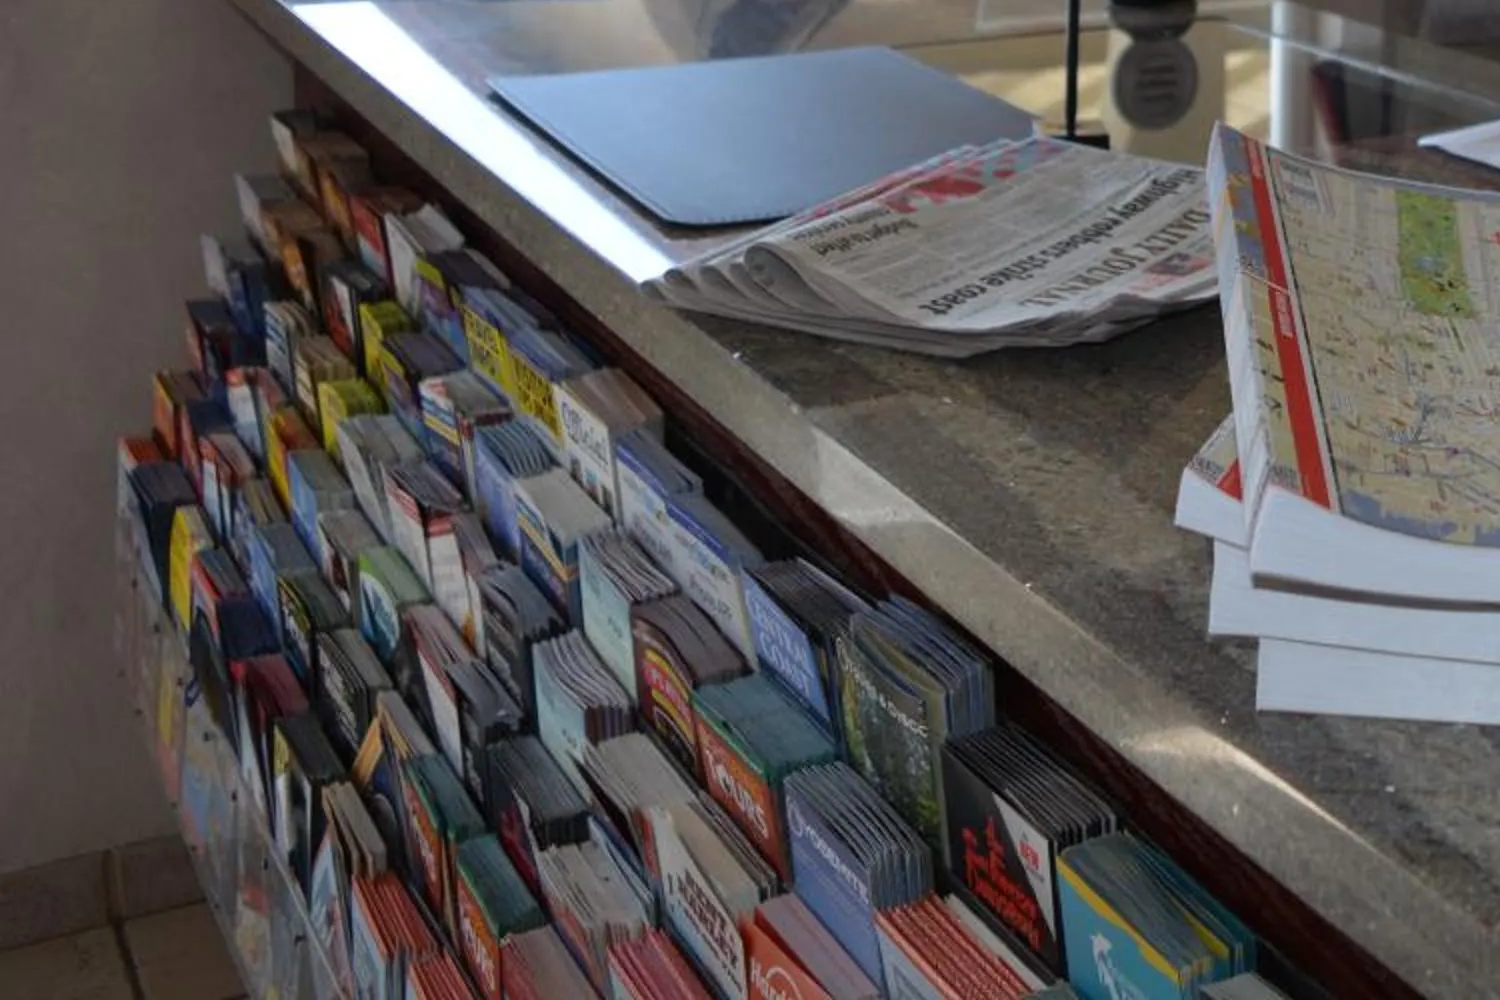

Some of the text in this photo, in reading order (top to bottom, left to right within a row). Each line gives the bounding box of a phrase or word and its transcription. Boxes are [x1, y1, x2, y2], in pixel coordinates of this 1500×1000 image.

[1020, 207, 1211, 307] DAILY JOURNAL
[918, 280, 987, 316] coast
